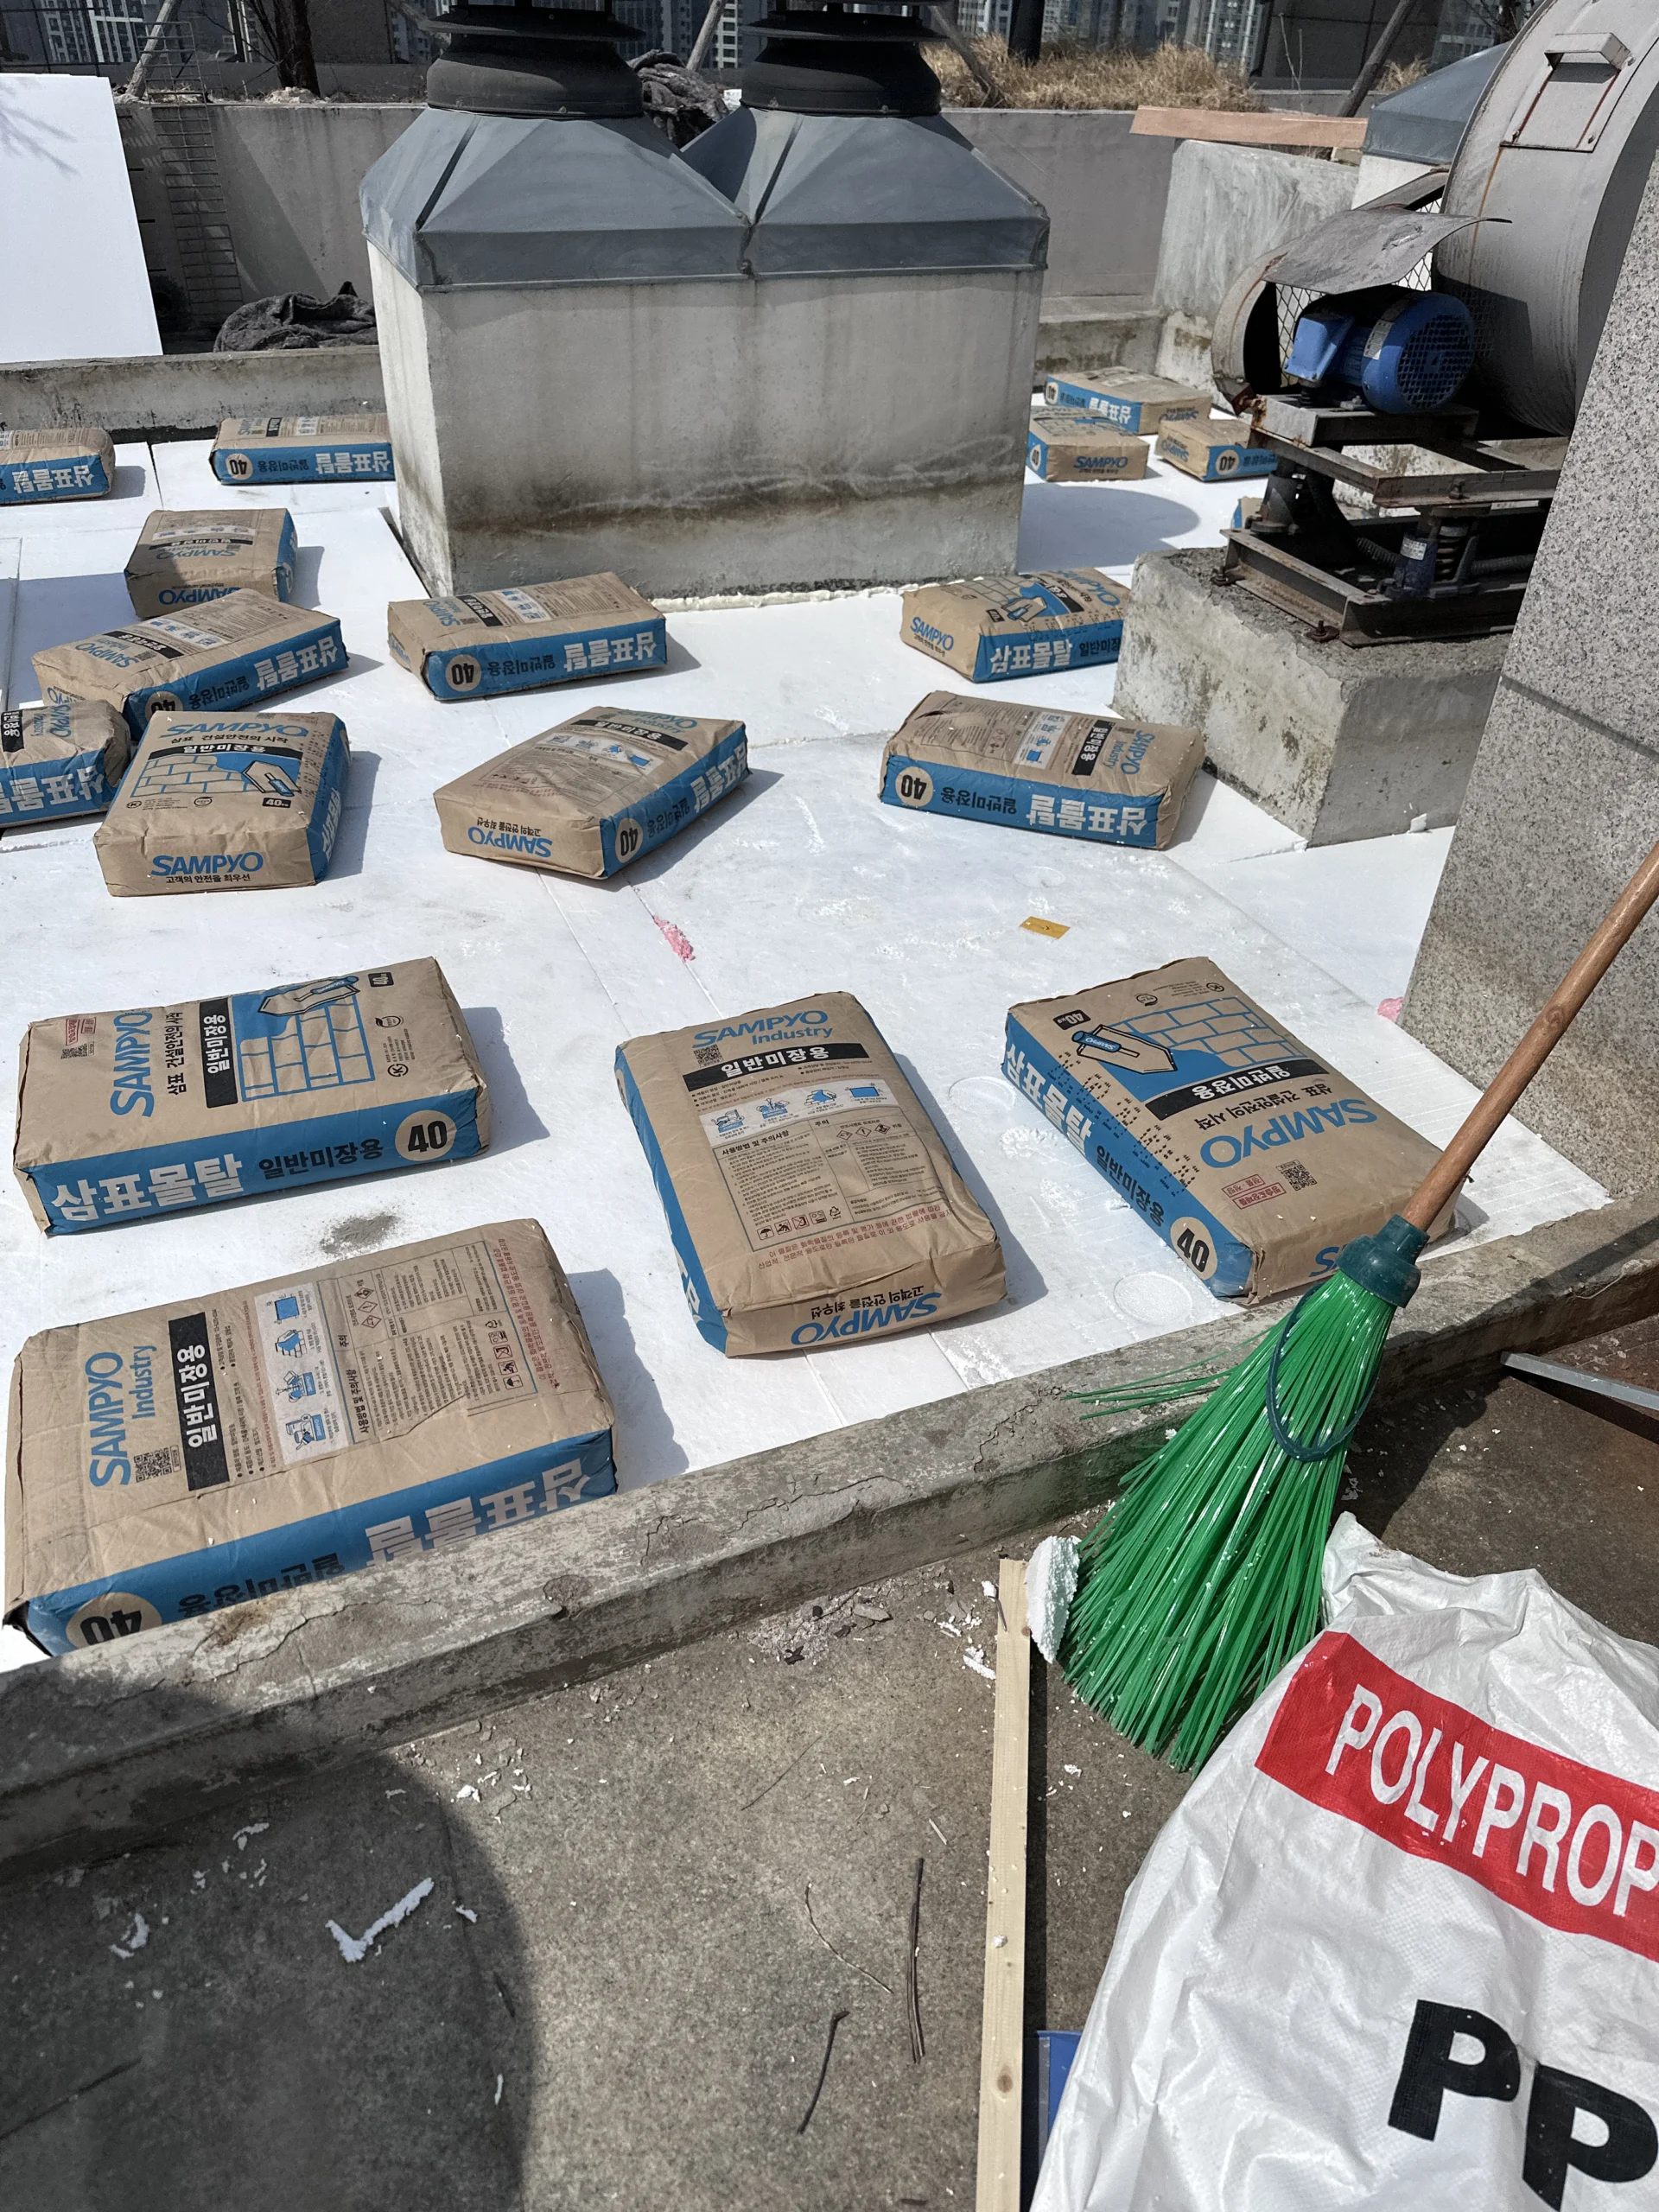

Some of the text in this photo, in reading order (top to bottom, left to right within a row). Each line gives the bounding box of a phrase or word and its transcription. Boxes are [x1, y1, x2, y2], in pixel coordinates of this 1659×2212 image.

[229, 460, 247, 475] 40
[257, 459, 309, 472] 일반미장용
[315, 450, 390, 474] 삼표몰탈
[1073, 455, 1128, 468] SAMPYO
[1219, 457, 1236, 472] 40
[11, 464, 93, 493] 삼표몰탈
[156, 549, 235, 559] SAMPYO
[909, 616, 955, 652] SAMPYO
[75, 642, 137, 669] SAMPYO
[254, 634, 340, 691] 삼표몰탈
[486, 653, 556, 678] 일반미장용
[563, 631, 657, 673] 삼표몰탈
[989, 639, 1074, 675] 삼표몰탈
[451, 664, 474, 686] 40
[188, 675, 251, 709] 일반미장용
[159, 721, 309, 739] SAMPYO
[171, 733, 289, 744] 삼표 건설안전의 시작
[183, 742, 266, 753] 일반미장용
[1120, 729, 1156, 776] SAMPYO
[691, 741, 747, 812] 삼표몰탈
[900, 774, 928, 800] 40
[940, 786, 1018, 815] 일반미장용
[1025, 793, 1148, 836] 삼표몰탈
[646, 797, 690, 840] 일반미장용
[467, 826, 553, 858] SAMPYO
[620, 827, 639, 856] 40
[150, 851, 264, 876] SAMPYO
[165, 873, 251, 884] 고객의 안전을 최우선
[203, 1014, 230, 1074] 일반미장용
[693, 1010, 829, 1049] SAMPYO
[752, 1026, 834, 1046] Industry
[163, 1026, 185, 1068] 건설안전의
[721, 1046, 830, 1078] 일반미장용
[110, 1011, 155, 1117] SAMPYO
[167, 1072, 187, 1095] 삼표
[1192, 1064, 1291, 1100] 일반미장용
[1193, 1082, 1333, 1130] 삼표 건설안전의 시작
[814, 1119, 830, 1128] 주의
[1200, 1098, 1377, 1169] SAMPYO
[721, 1140, 751, 1157] 사용방법
[753, 1137, 761, 1148] 및
[761, 1128, 791, 1147] 주의사항
[1005, 1042, 1211, 1273] 삼표몰탈 일반미장용 40
[52, 1119, 448, 1222] 삼표몰탈 일반미장용 40
[791, 1292, 943, 1346] SAMPYO
[810, 1286, 925, 1319] 고객의 안전을 최우선
[337, 1332, 349, 1348] 주의
[132, 1344, 157, 1420] Industry
[176, 1342, 219, 1450] 일반미장용
[346, 1368, 371, 1434] 사용방법 및 주의사항
[85, 1351, 131, 1487] SAMPYO
[365, 1459, 589, 1567] 삼표몰탈
[1325, 1683, 1659, 1917] POLYPROP
[1388, 1999, 1659, 2212] PP
